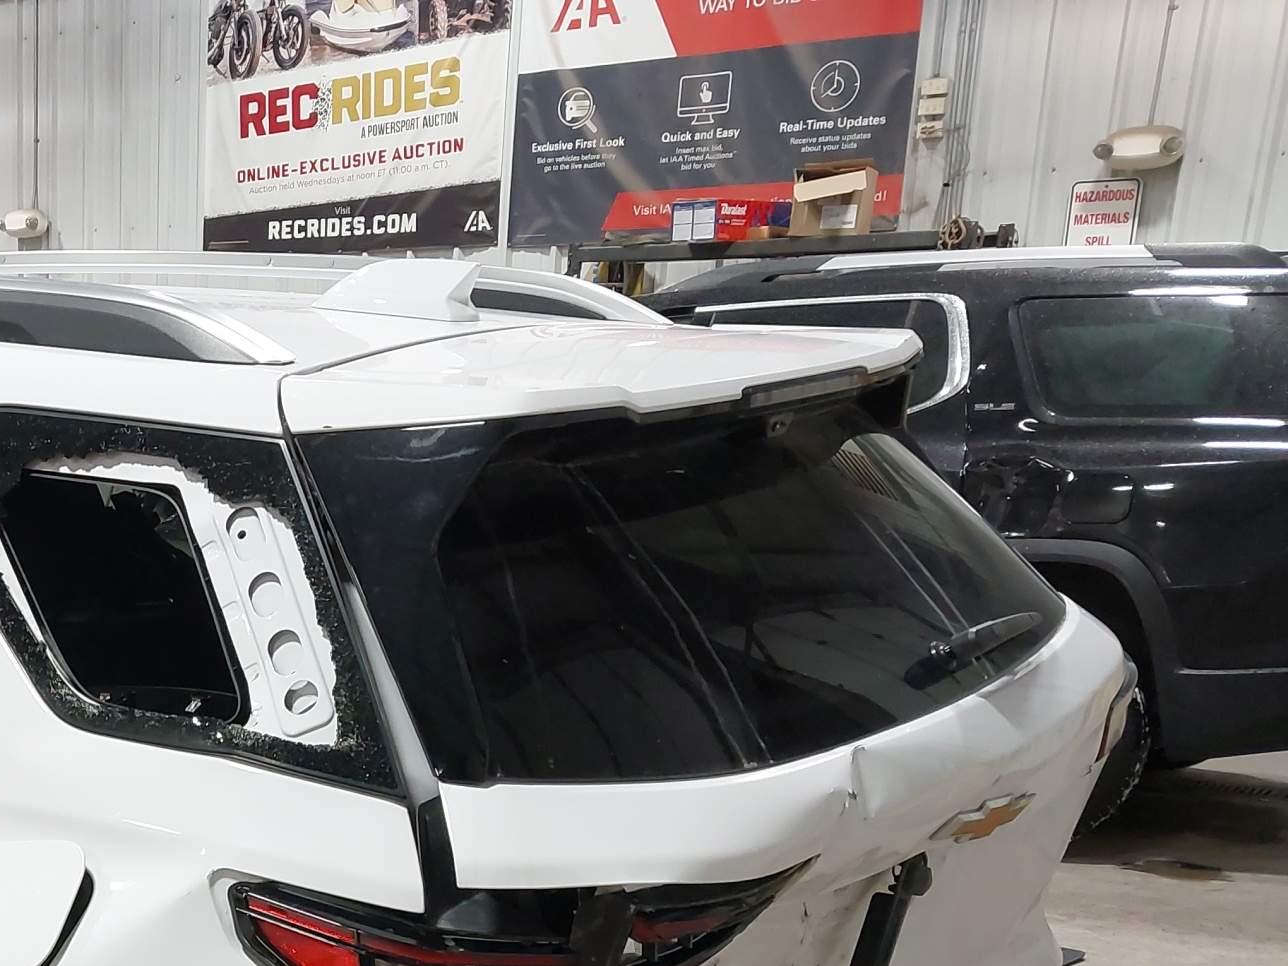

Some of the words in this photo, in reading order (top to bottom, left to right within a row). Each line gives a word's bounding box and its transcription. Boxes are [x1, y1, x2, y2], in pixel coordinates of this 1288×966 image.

[360, 126, 366, 139] A
[367, 116, 421, 137] POWERSPORT
[422, 110, 459, 129] AUCTION
[779, 118, 835, 133] Real-Time
[837, 115, 887, 130] Updates
[661, 131, 692, 143] Quick
[694, 128, 714, 140] and
[716, 127, 741, 139] Easy
[841, 132, 872, 142] updates
[532, 140, 573, 153] Exclusive
[575, 138, 597, 150] First
[599, 136, 625, 148] Look
[800, 144, 822, 153] about
[822, 144, 840, 152] your
[237, 149, 387, 184] ONLINE-EXCLUSIVE
[391, 137, 464, 161] AUCTION
[684, 153, 704, 162] Timed
[248, 183, 278, 194] Auction
[278, 181, 295, 190] held
[296, 176, 345, 189] Wednesdays
[346, 174, 355, 182] at
[1074, 188, 1135, 203] HAZARDOUS
[334, 206, 351, 215] Visit
[633, 203, 657, 216] Visit
[1074, 211, 1130, 225] MATERIALS
[267, 213, 417, 240] RECRIDES.COM
